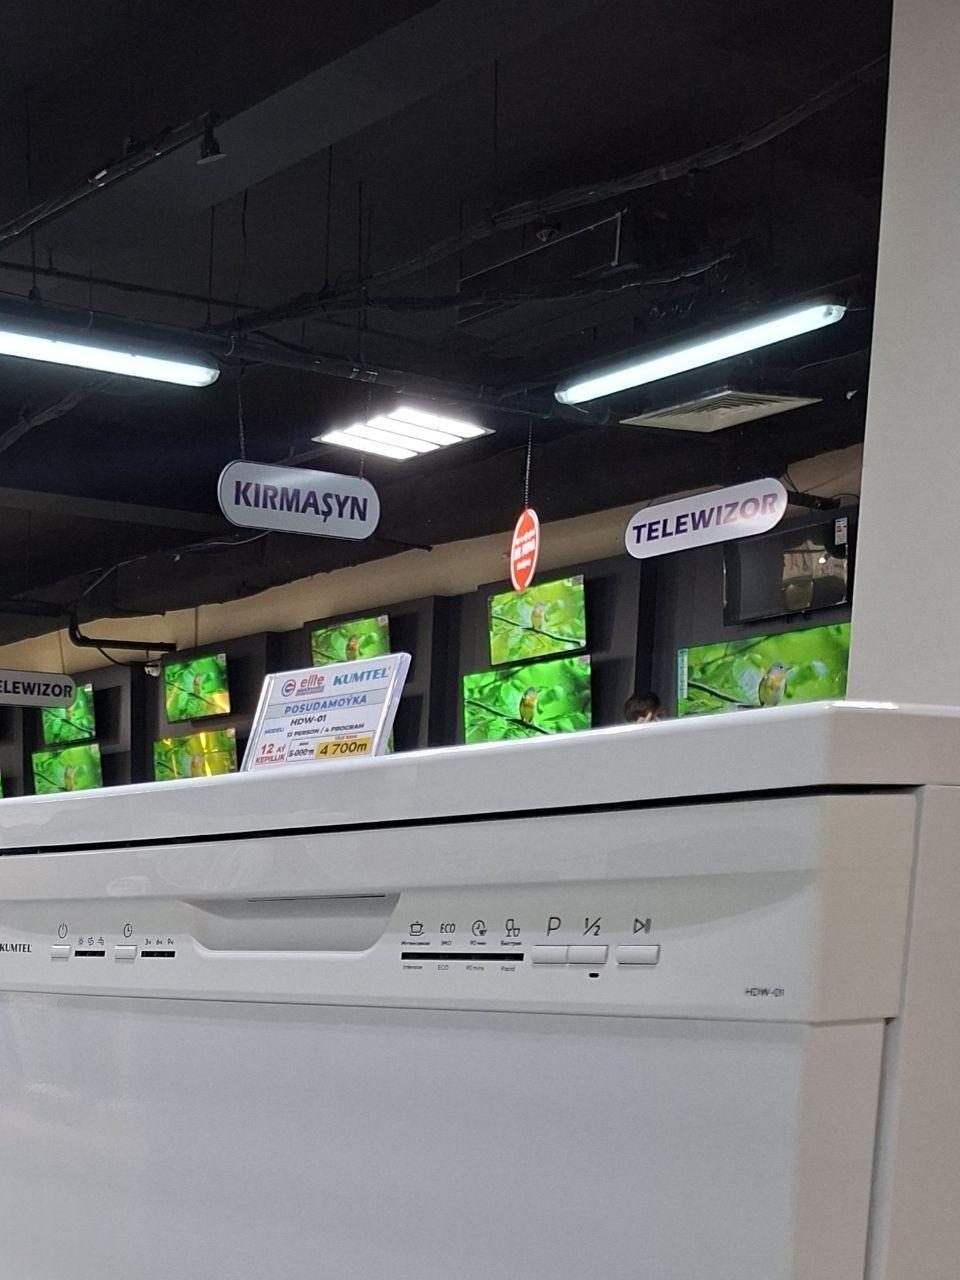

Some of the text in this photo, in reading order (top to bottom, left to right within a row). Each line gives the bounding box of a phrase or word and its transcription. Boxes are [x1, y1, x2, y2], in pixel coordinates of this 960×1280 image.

[233, 480, 368, 523] KIRMAŞYN
[632, 492, 779, 545] TELEWIZOR
[300, 674, 325, 688] elite
[333, 668, 389, 687] KUMTEL
[284, 694, 367, 715] POSUDAMOÝKA
[289, 714, 327, 727] HDW-01
[293, 727, 320, 737] PERSON
[260, 743, 275, 755] 12
[440, 923, 456, 934] ECO
[546, 917, 561, 936] P
[0, 943, 32, 953] KUMTEL
